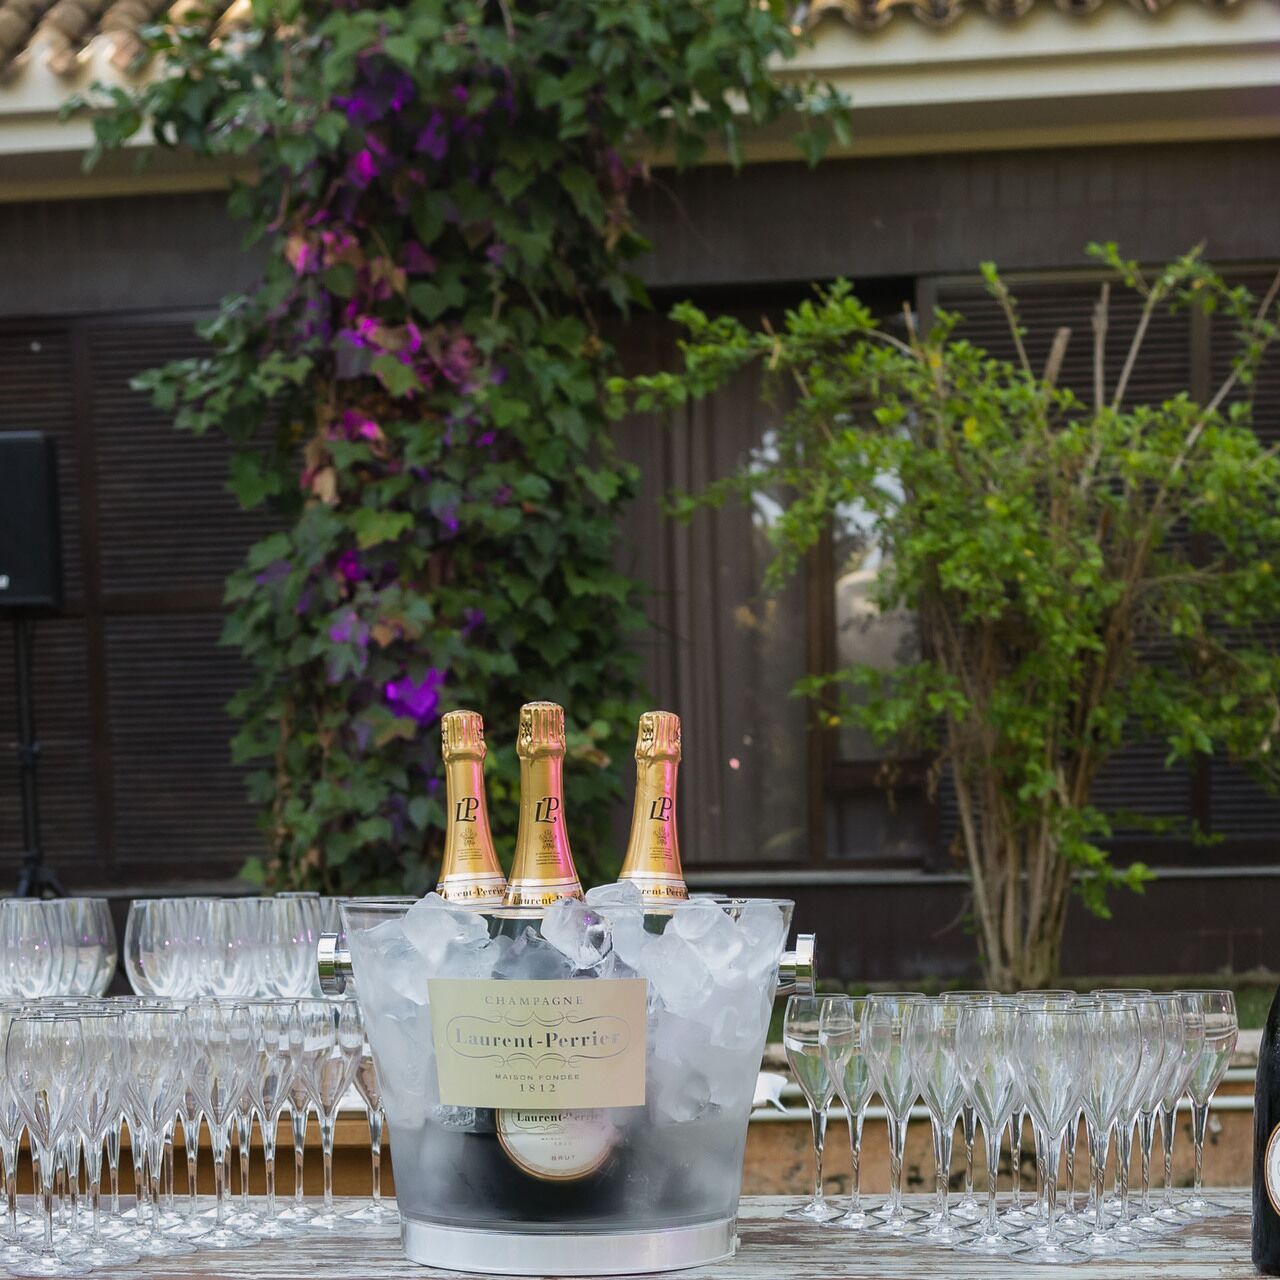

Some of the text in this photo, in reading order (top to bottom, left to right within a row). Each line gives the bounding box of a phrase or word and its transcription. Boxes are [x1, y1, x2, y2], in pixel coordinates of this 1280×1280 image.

[485, 996, 584, 1006] CHAMPAGNE
[456, 1028, 620, 1048] Laurent-Perrier
[520, 1083, 556, 1093] 1812
